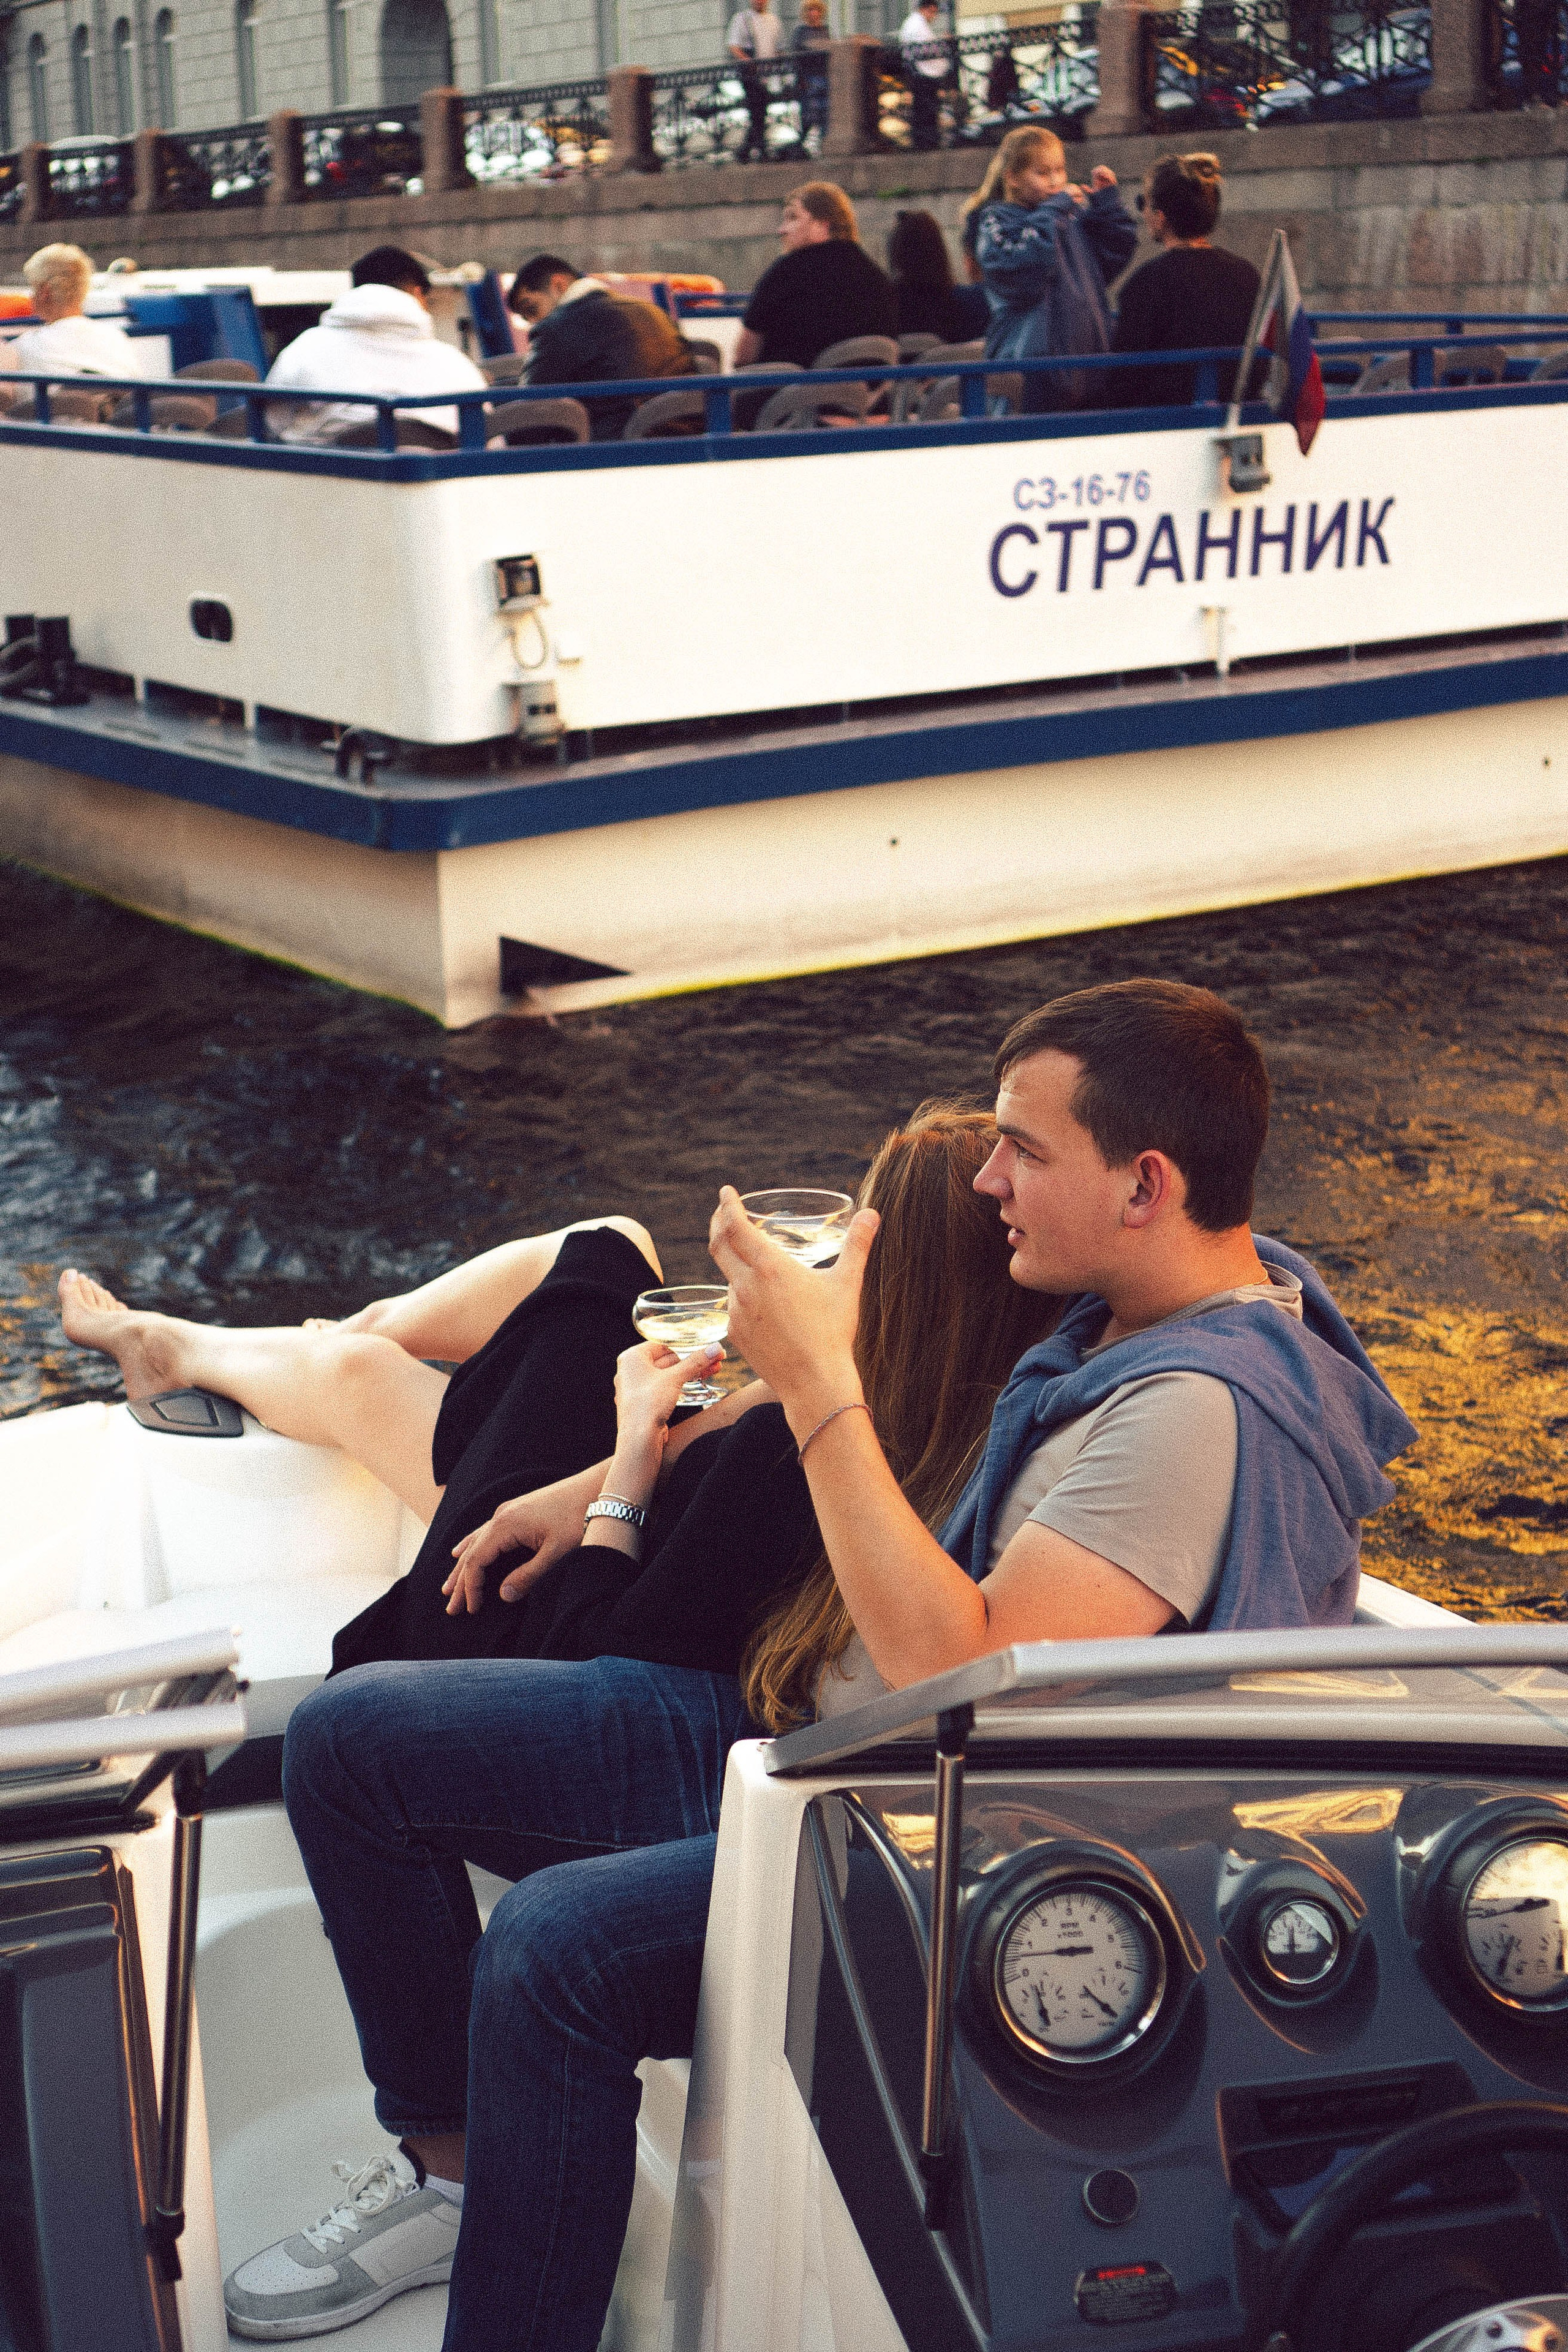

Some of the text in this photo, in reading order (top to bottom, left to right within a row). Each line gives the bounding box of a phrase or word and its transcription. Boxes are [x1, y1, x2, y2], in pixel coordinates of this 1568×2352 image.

[988, 497, 1396, 598] СТРАННИК
[1115, 1961, 1122, 1969] 6
[1022, 1968, 1030, 1977] 0
